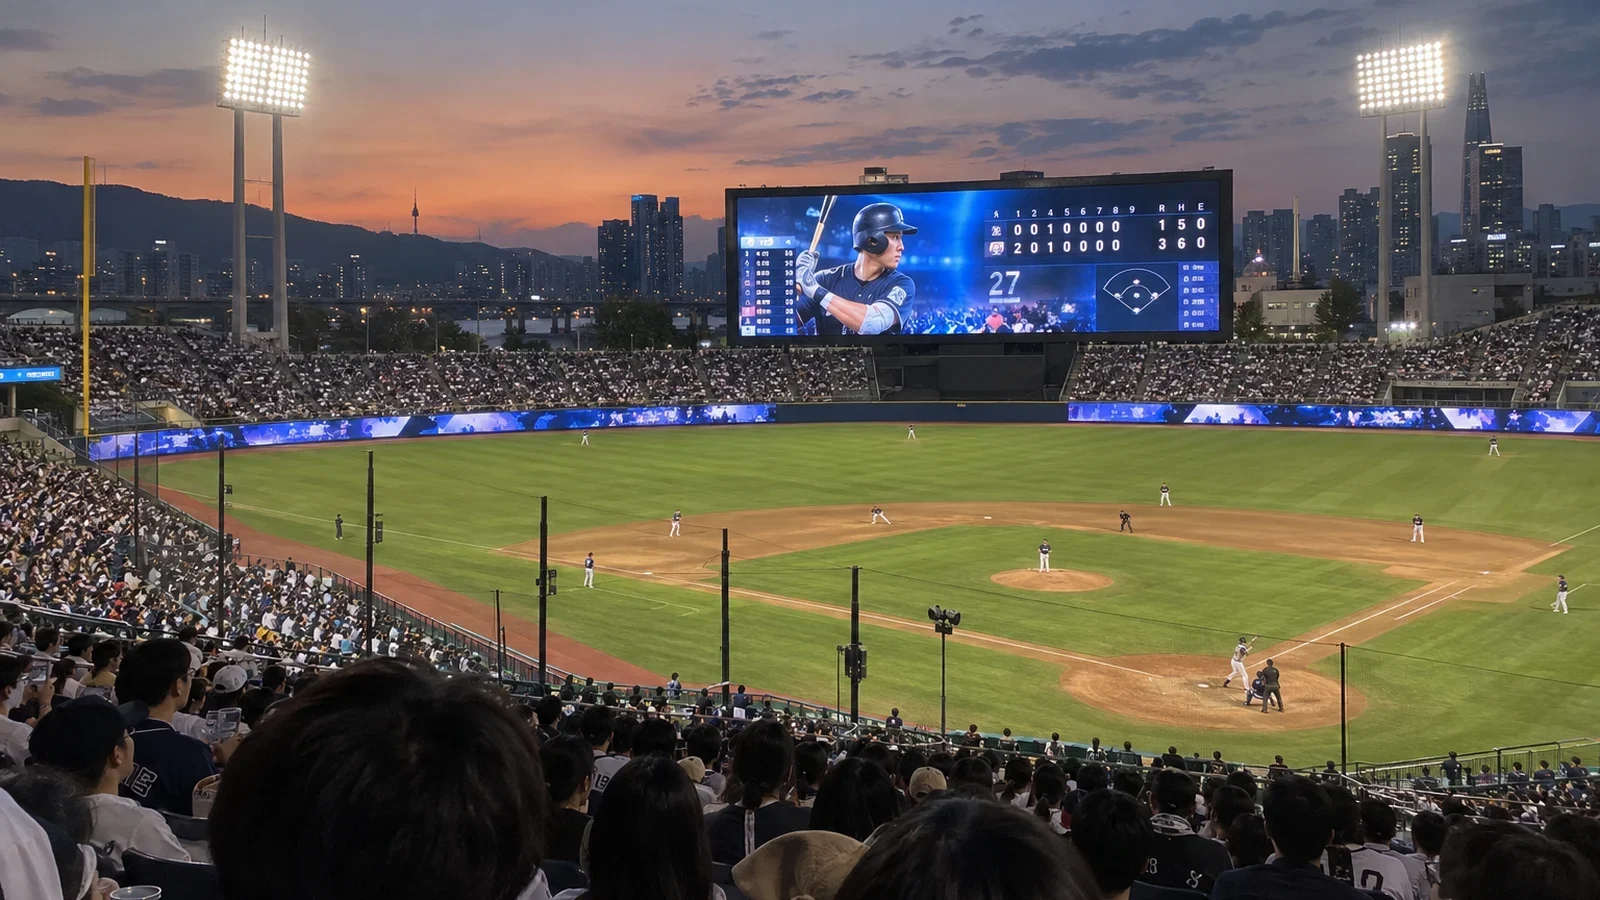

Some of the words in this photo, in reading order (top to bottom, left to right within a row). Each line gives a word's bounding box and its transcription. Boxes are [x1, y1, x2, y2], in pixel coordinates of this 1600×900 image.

[1031, 209, 1037, 218] 2
[1064, 207, 1070, 217] 5
[1080, 207, 1087, 216] 6
[1096, 206, 1103, 215] 7
[1112, 206, 1119, 215] 8
[1129, 205, 1136, 214] 9
[1158, 204, 1166, 213] R
[1178, 203, 1185, 212] H
[1197, 202, 1204, 211] E
[1014, 224, 1022, 236] 0
[1030, 223, 1039, 236] 0
[1047, 223, 1053, 235] 1
[1063, 222, 1071, 234] 0
[1079, 221, 1088, 234] 0
[1095, 221, 1104, 233] 0
[1111, 220, 1120, 233] 0
[1158, 218, 1165, 231] 1
[1177, 218, 1186, 231] 5
[1196, 217, 1206, 230] 0
[1013, 242, 1022, 254] 2
[1030, 241, 1039, 254] 0
[1047, 241, 1053, 253] 1
[1063, 240, 1071, 253] 0
[1079, 240, 1088, 252] 0
[1095, 239, 1104, 252] 0
[1111, 239, 1120, 251] 0
[1158, 237, 1167, 250] 3
[1177, 237, 1186, 250] 6
[1196, 236, 1205, 249] 0
[989, 271, 1020, 296] 27
